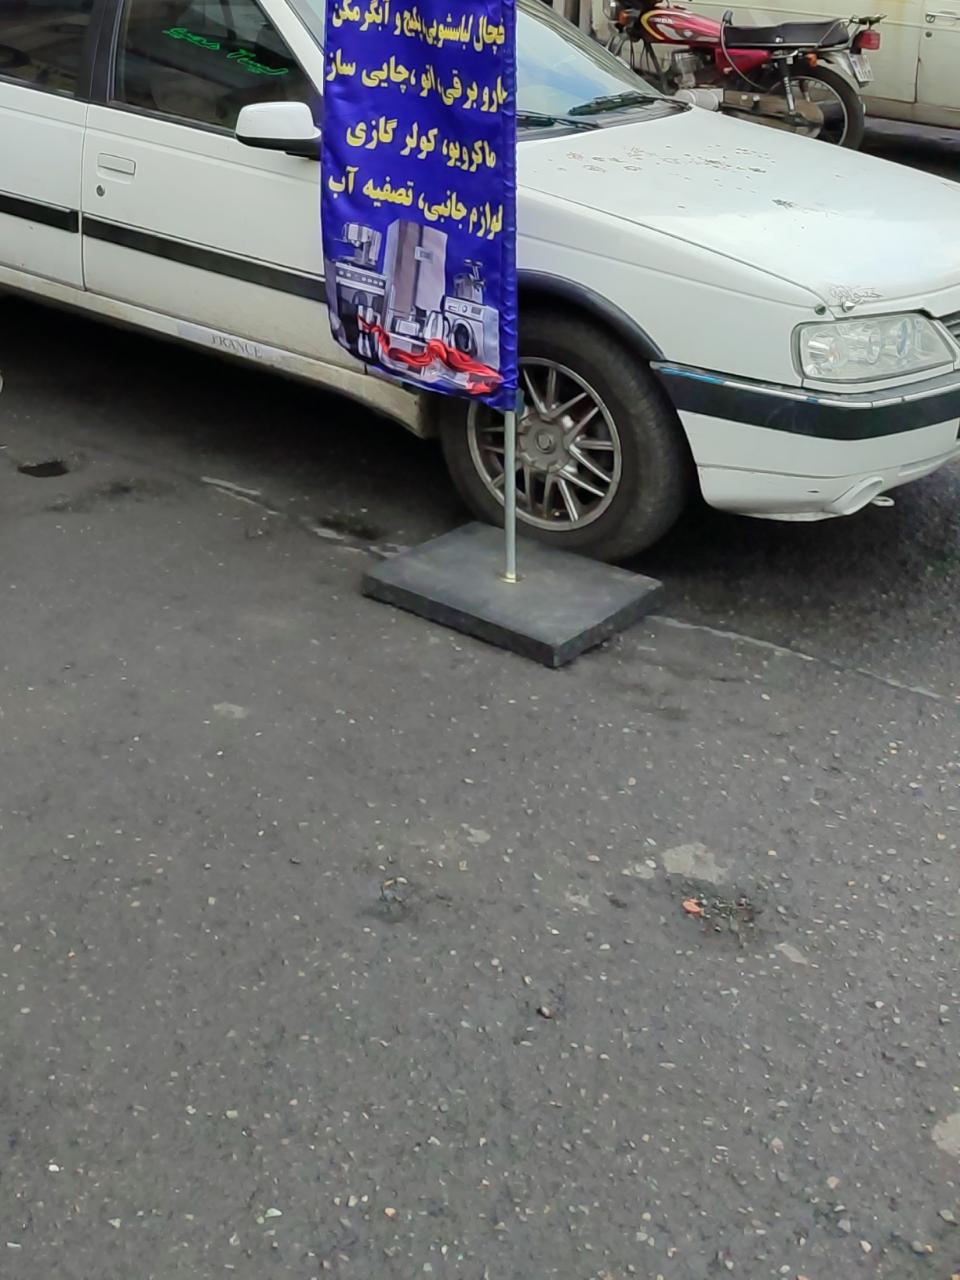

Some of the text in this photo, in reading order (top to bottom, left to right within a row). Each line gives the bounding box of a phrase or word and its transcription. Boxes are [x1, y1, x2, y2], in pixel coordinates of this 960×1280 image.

[394, 12, 401, 36] و
[326, 48, 356, 81] ساز
[346, 116, 398, 150] گازی
[400, 122, 438, 159] کولر
[328, 166, 359, 199] آب
[362, 176, 414, 208] تصفیه
[468, 202, 504, 241] لوازم
